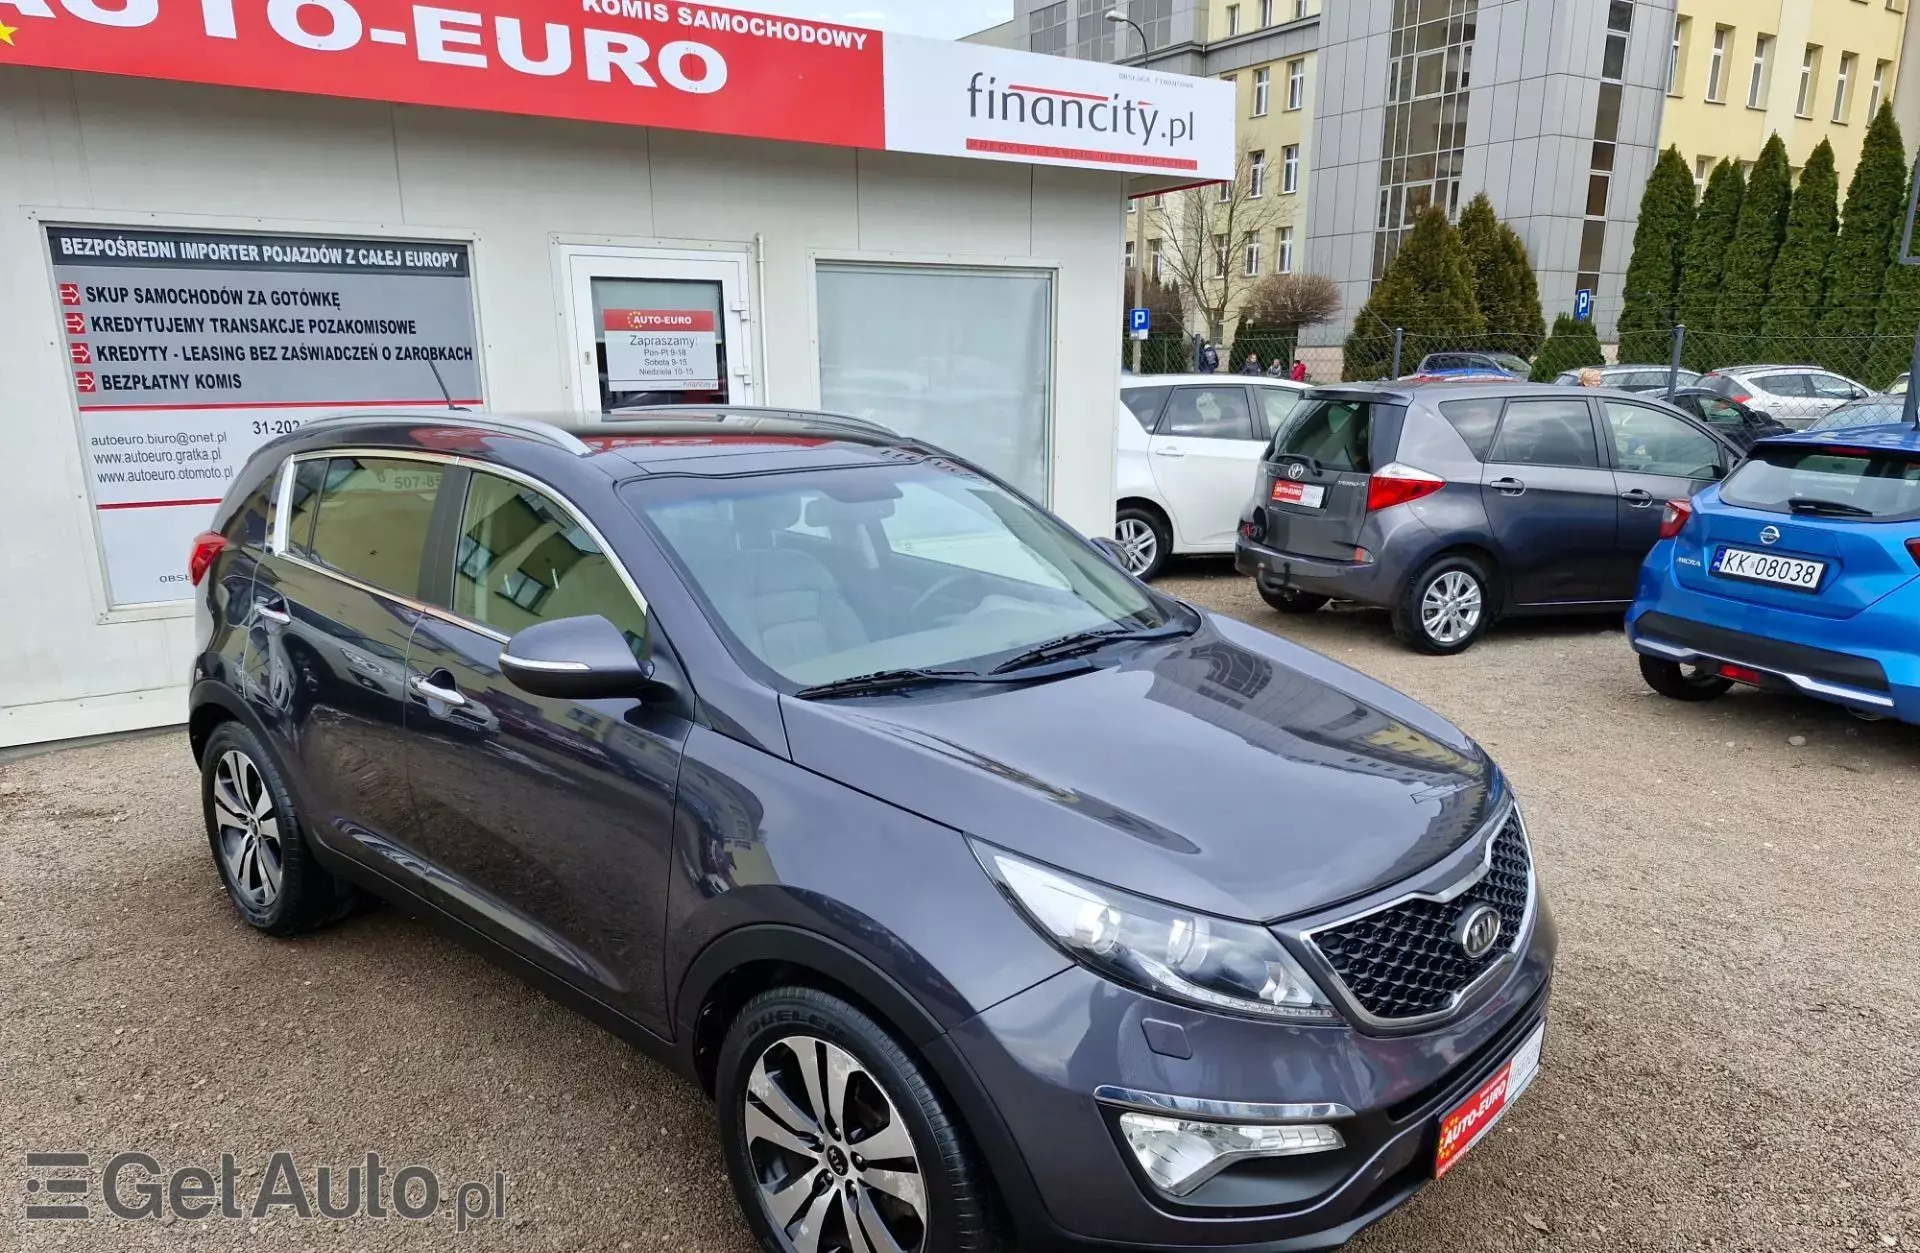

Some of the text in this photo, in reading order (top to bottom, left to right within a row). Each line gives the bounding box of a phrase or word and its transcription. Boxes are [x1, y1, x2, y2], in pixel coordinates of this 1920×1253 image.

[582, 0, 868, 51] KOMIS SAMOCHODOWY
[966, 71, 1195, 147] financity.pl
[60, 236, 459, 268] BEZPOŚREDNI IMPORTER POJAZDÓW Z CAŁEJ EUROPY
[86, 285, 341, 311] SKUP SAMOCHODÓW ZA GOTÓWKĘ
[1579, 292, 1588, 313] P
[91, 316, 417, 335] KREDYTUJEMY TRANSAKCJE POZAKOMISOWE
[633, 316, 692, 325] AUTO-EURO
[1134, 311, 1146, 328] P
[629, 334, 698, 348] Zapraszamy:
[96, 345, 168, 362] KREDYTY
[182, 345, 245, 361] LEASING
[250, 346, 277, 361] BEZ
[281, 342, 379, 361] ZAŚWIADCZEŃ
[382, 346, 391, 361] O
[396, 346, 473, 361] ZAROBKACH
[101, 373, 242, 391] BEZPŁATNY KOMIS
[91, 431, 227, 447] autoeuro.biuro@onet.pl
[94, 448, 222, 465] www.autoeuro.gratka.pl
[97, 466, 234, 483] www.autoeuro.otomoto.pl
[1724, 552, 1817, 584] KK 08038
[1444, 1079, 1507, 1149] AUTO-EURO
